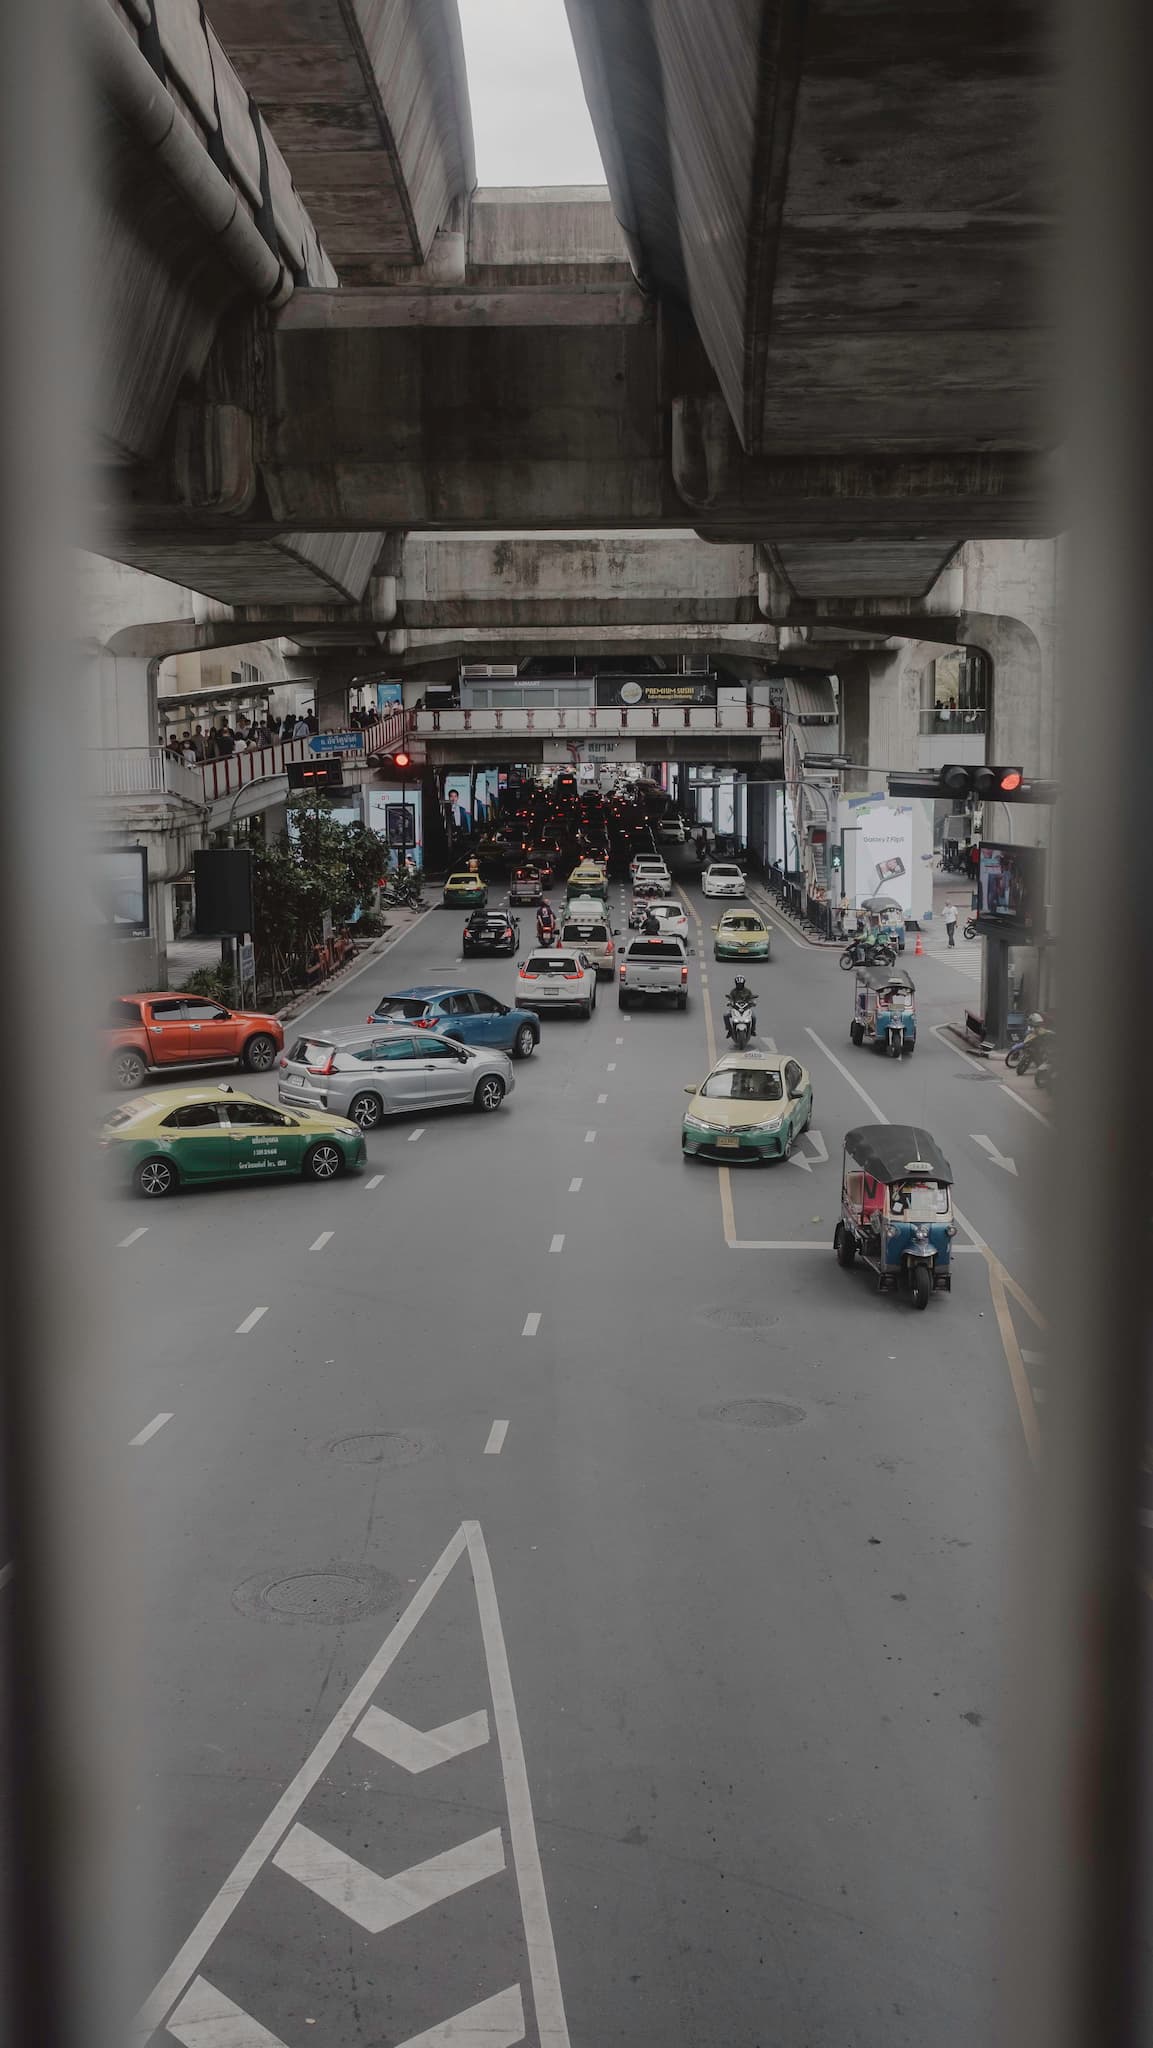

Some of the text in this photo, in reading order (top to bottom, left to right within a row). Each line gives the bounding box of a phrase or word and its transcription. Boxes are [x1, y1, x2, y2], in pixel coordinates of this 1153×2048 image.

[645, 687, 695, 695] PREMIUM SUSHI
[588, 743, 614, 752] สยาม
